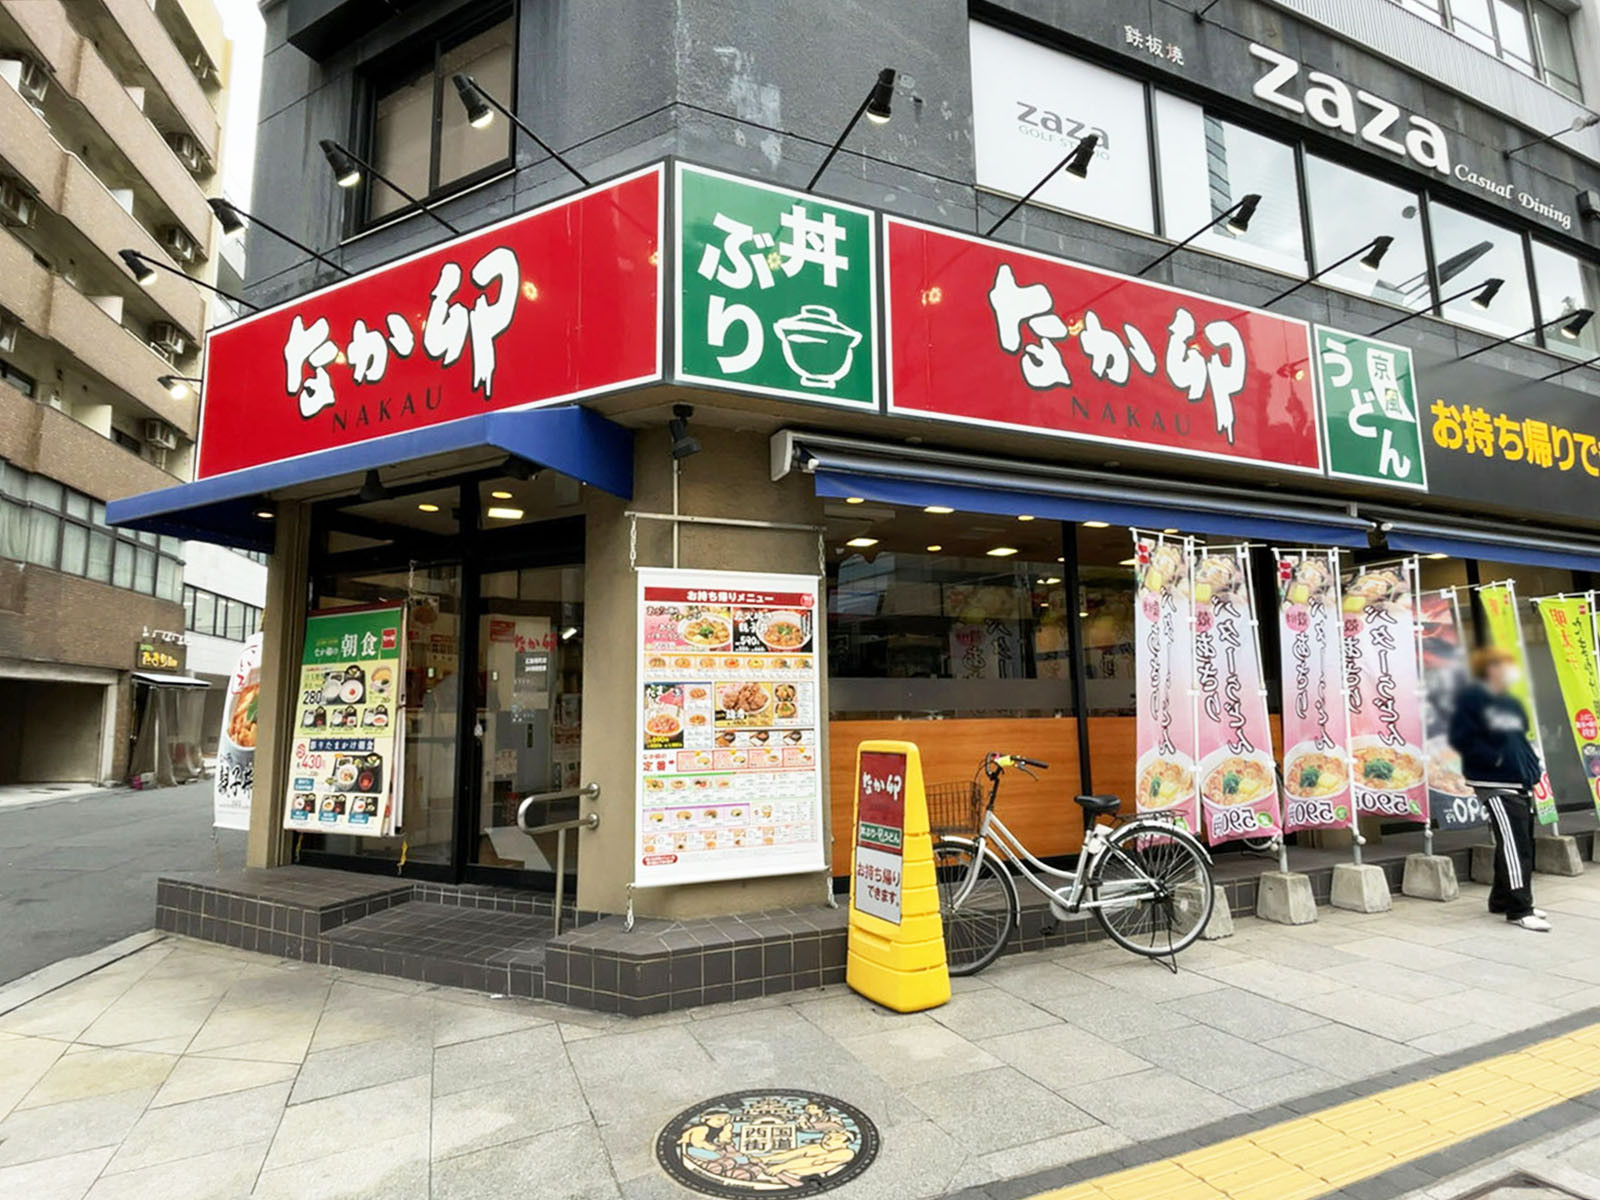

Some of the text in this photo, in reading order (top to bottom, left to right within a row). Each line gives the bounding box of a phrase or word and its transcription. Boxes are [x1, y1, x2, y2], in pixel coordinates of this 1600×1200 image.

[1249, 42, 1450, 175] zaza
[1018, 124, 1053, 143] GOLF
[1454, 163, 1572, 231] Casual Dining
[284, 246, 521, 419] なか卯
[988, 263, 1247, 446] なか卯
[330, 383, 443, 434] NAKAU
[1070, 396, 1192, 437] NAKAU
[1323, 336, 1412, 479] うどん
[686, 590, 775, 604] お持ち帰りメニュー
[341, 631, 378, 658] 朝食
[862, 771, 902, 801] なか卯
[857, 863, 901, 887] お持ち帰り
[867, 884, 900, 907] できます。
